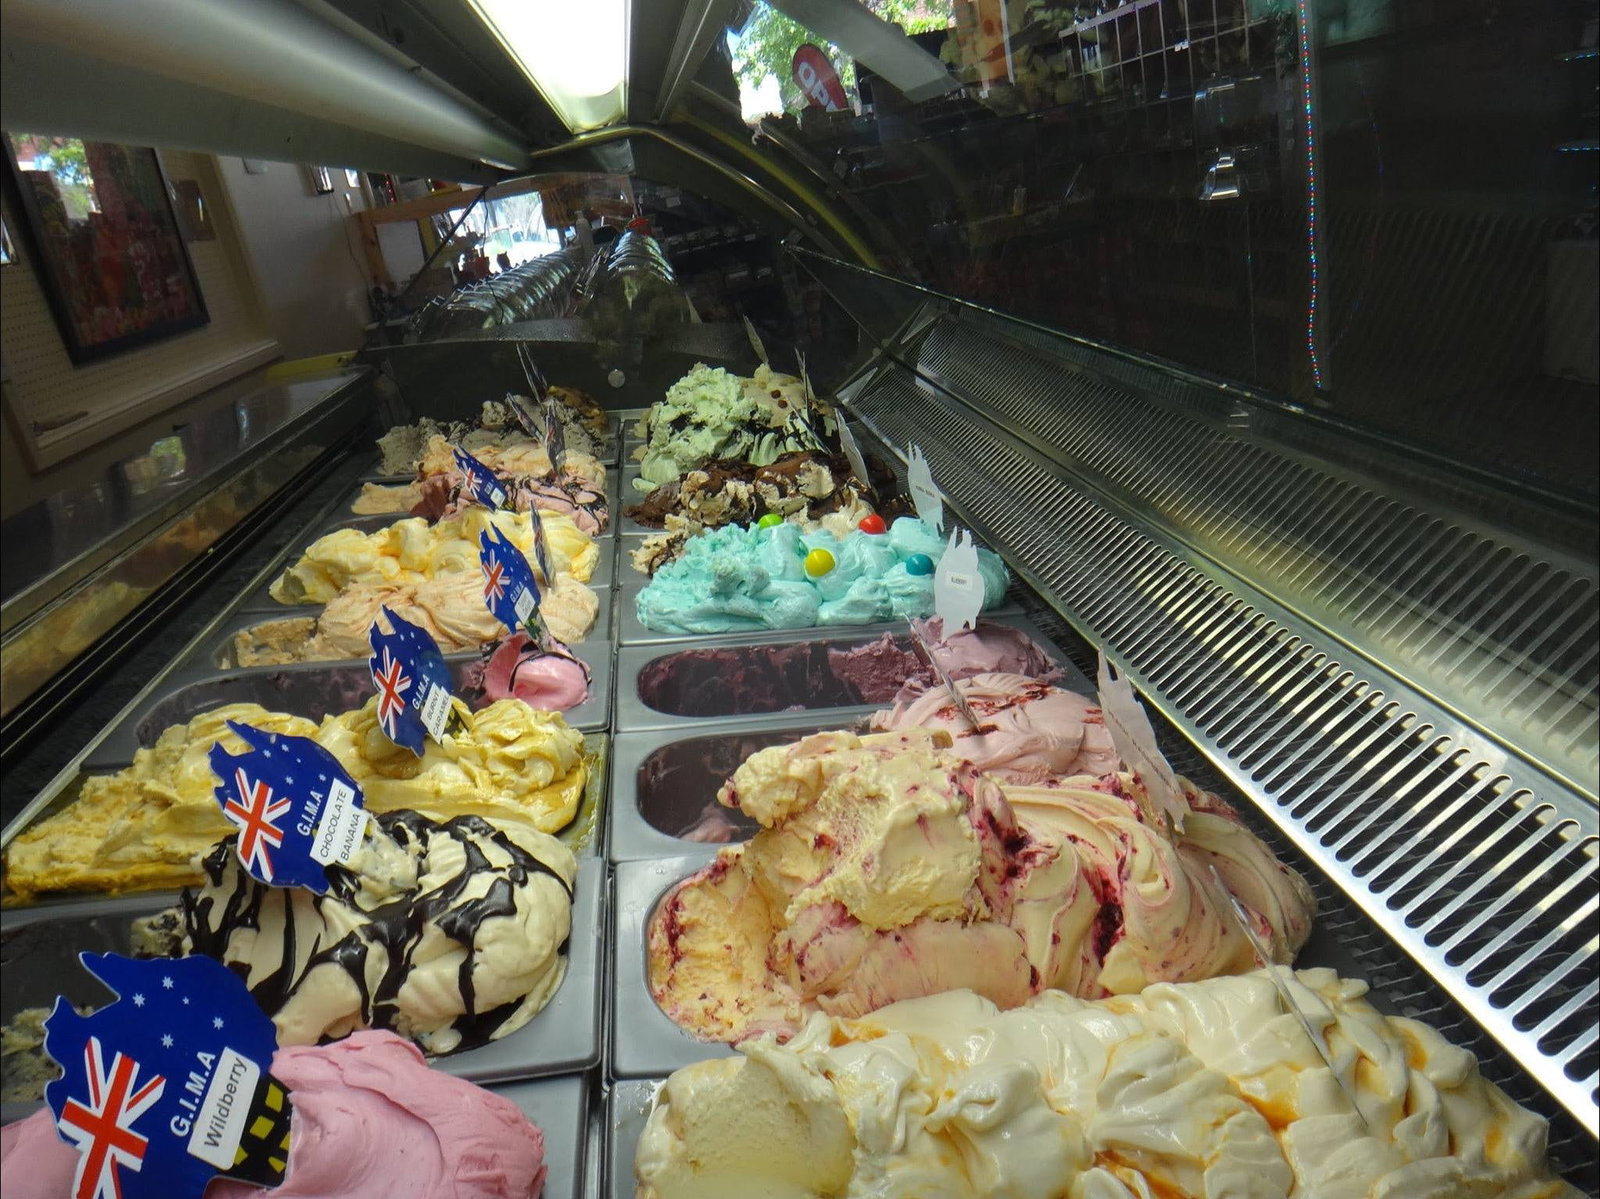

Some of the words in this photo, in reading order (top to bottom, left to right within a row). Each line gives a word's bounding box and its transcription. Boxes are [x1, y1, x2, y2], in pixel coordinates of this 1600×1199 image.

[412, 673, 430, 710] G.I.M.A
[427, 691, 440, 721] BURNT
[432, 695, 450, 736] CARAMEL
[296, 789, 324, 837] G.I.M.A
[320, 788, 347, 858] CHOCOLATE
[340, 813, 360, 861] BANANA
[170, 1050, 216, 1138] G.I.M.A
[203, 1056, 248, 1149] Wildberry
